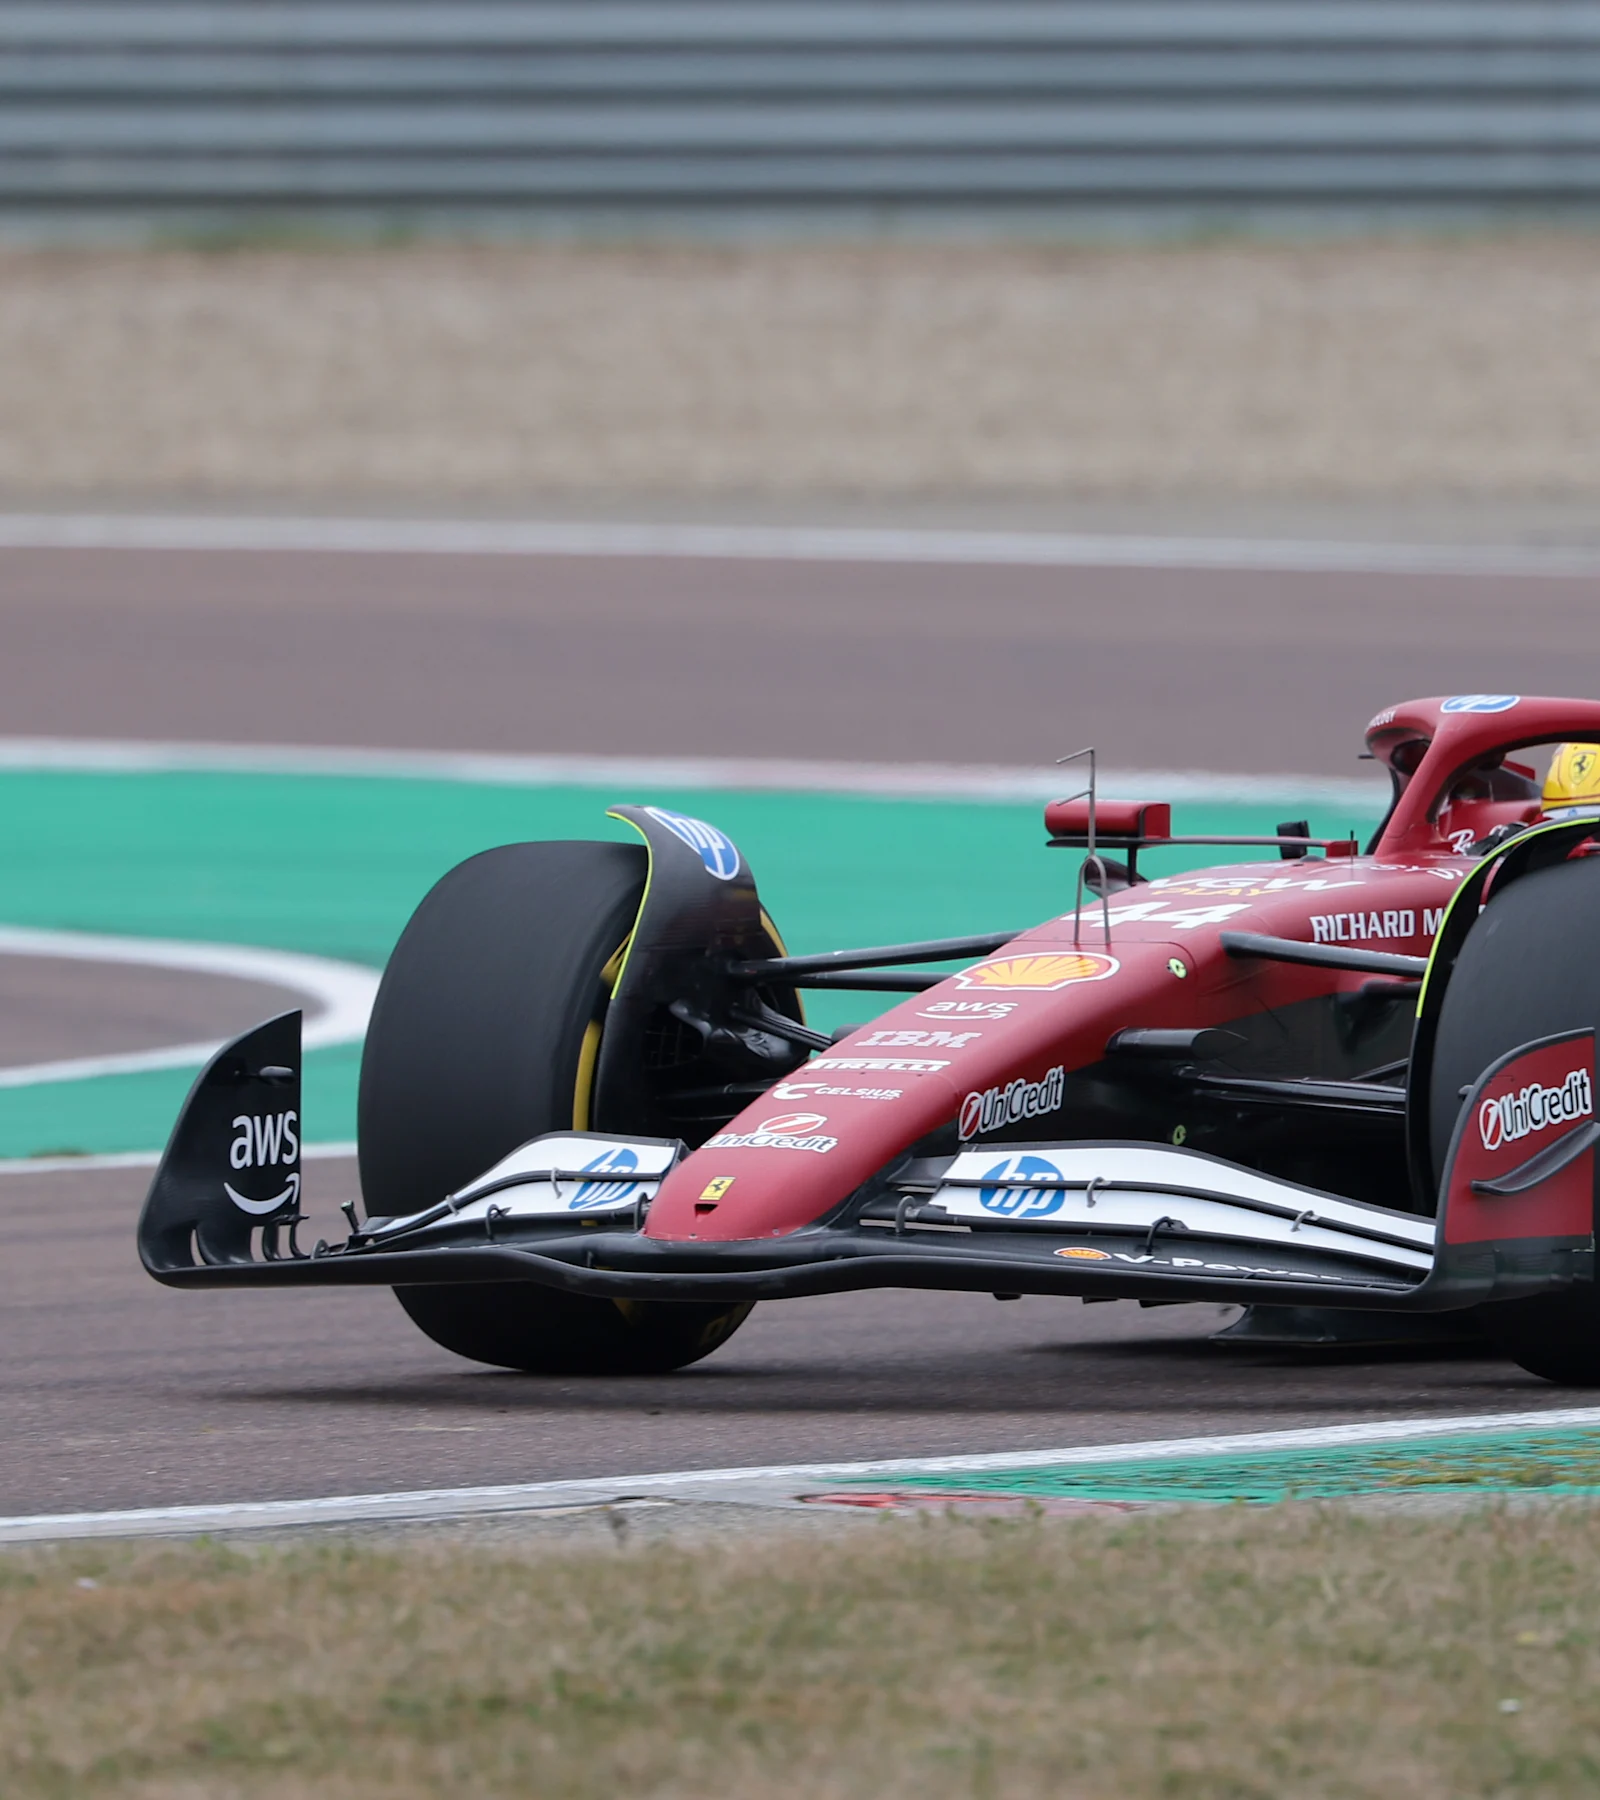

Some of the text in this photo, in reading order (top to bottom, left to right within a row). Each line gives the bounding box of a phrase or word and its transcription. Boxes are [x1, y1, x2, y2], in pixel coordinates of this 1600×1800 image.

[643, 806, 740, 880] hp
[1148, 878, 1366, 891] VGW
[1151, 887, 1283, 897] PLAY
[1060, 902, 1252, 929] 44
[1310, 909, 1415, 943] RICHARD
[925, 1000, 1019, 1013] aws
[854, 1031, 983, 1048] IBM
[804, 1058, 952, 1072] PIRELLI
[814, 1087, 904, 1099] CELSIUS
[981, 1066, 1064, 1132] UniCredit
[1500, 1070, 1591, 1140] UniCredit
[229, 1110, 299, 1169] aws
[703, 1133, 838, 1153] UniCredit
[568, 1148, 639, 1211] hp
[979, 1155, 1066, 1218] hp
[1113, 1253, 1342, 1280] V-Power
